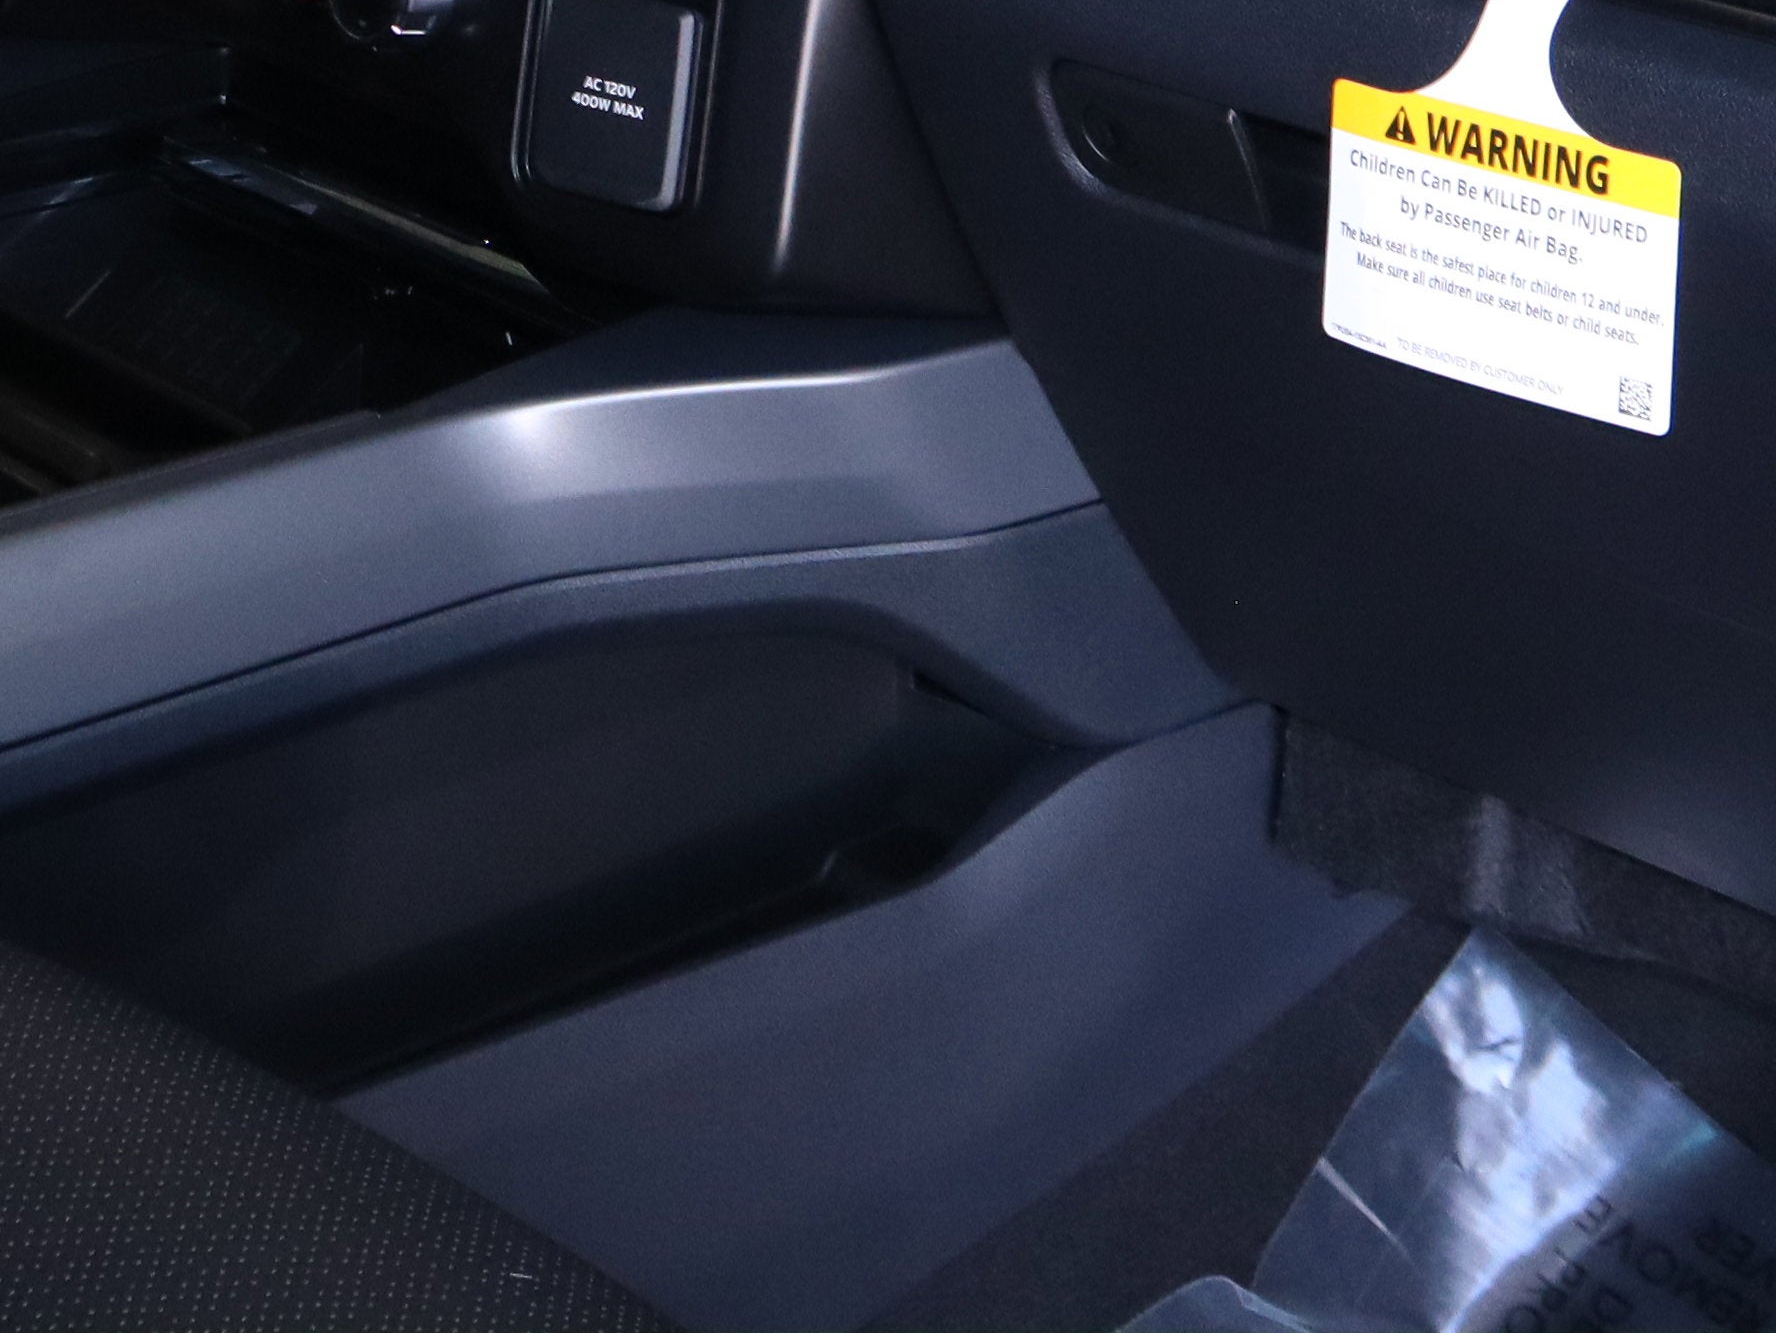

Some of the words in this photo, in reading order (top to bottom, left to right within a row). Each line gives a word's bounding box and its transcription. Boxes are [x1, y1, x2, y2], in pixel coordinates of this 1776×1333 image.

[571, 91, 612, 112] 400W
[612, 101, 644, 120] MAX
[583, 75, 603, 92] AC
[603, 80, 637, 99] 120V
[1425, 112, 1610, 196] WARNING
[1350, 149, 1416, 184] Children
[1421, 170, 1451, 194] Can
[1458, 180, 1478, 199] Be
[1483, 187, 1542, 217] KILLED
[1547, 208, 1566, 223] or
[1571, 209, 1648, 244] INJURED
[1400, 196, 1419, 221] by
[1425, 204, 1510, 242] Passenger
[1515, 232, 1540, 251] Air
[1546, 236, 1583, 265] Bag.
[1341, 222, 1357, 240] The
[1359, 227, 1383, 248] back
[1385, 238, 1407, 256] seat
[1410, 246, 1418, 259] is
[1422, 247, 1439, 265] the
[1442, 252, 1474, 276] safest
[1477, 265, 1506, 286] place
[1510, 273, 1527, 289] for
[1530, 280, 1577, 304] children
[1582, 292, 1595, 309] 12
[1599, 297, 1621, 315] and
[1625, 305, 1665, 327] under.
[1356, 252, 1384, 275] Make
[1387, 264, 1409, 282] sure
[1412, 270, 1425, 287] all
[1429, 276, 1472, 300] children
[1476, 290, 1494, 307] use
[1498, 296, 1521, 314] seat
[1525, 302, 1552, 324] belts
[1556, 312, 1568, 327] or
[1572, 314, 1601, 335] child
[1425, 346, 1468, 369] REMOVED
